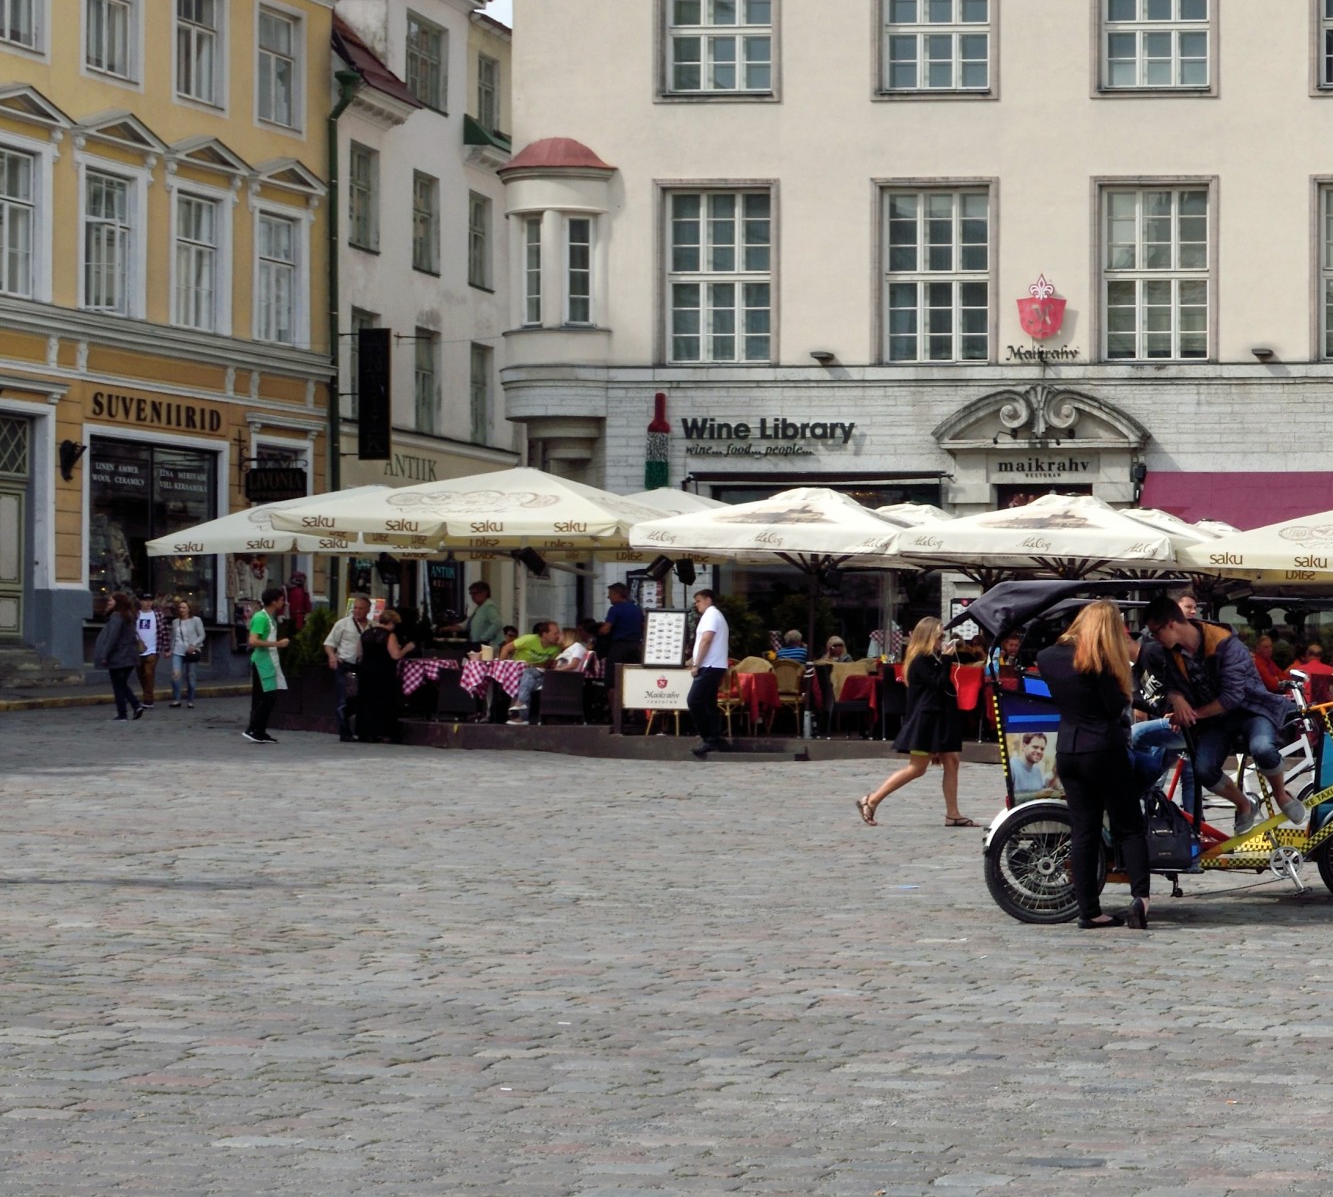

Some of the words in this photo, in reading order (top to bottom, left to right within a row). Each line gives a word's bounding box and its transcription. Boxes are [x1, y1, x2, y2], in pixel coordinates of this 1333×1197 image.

[92, 391, 221, 432] SUVENIIRID
[681, 418, 750, 440] Wine
[760, 418, 855, 444] Library
[384, 453, 437, 482] ANTIIK
[998, 458, 1090, 472] maikrahv
[92, 473, 110, 483] WOOL
[115, 475, 145, 486] CERAMICS
[302, 515, 335, 528] saku
[385, 518, 419, 532] saku
[470, 519, 503, 533] saku
[554, 519, 587, 533] saku
[174, 541, 204, 553] saku
[246, 538, 275, 549] saku
[319, 537, 348, 549] saku
[1210, 552, 1243, 565] saku
[1294, 555, 1328, 569] saku
